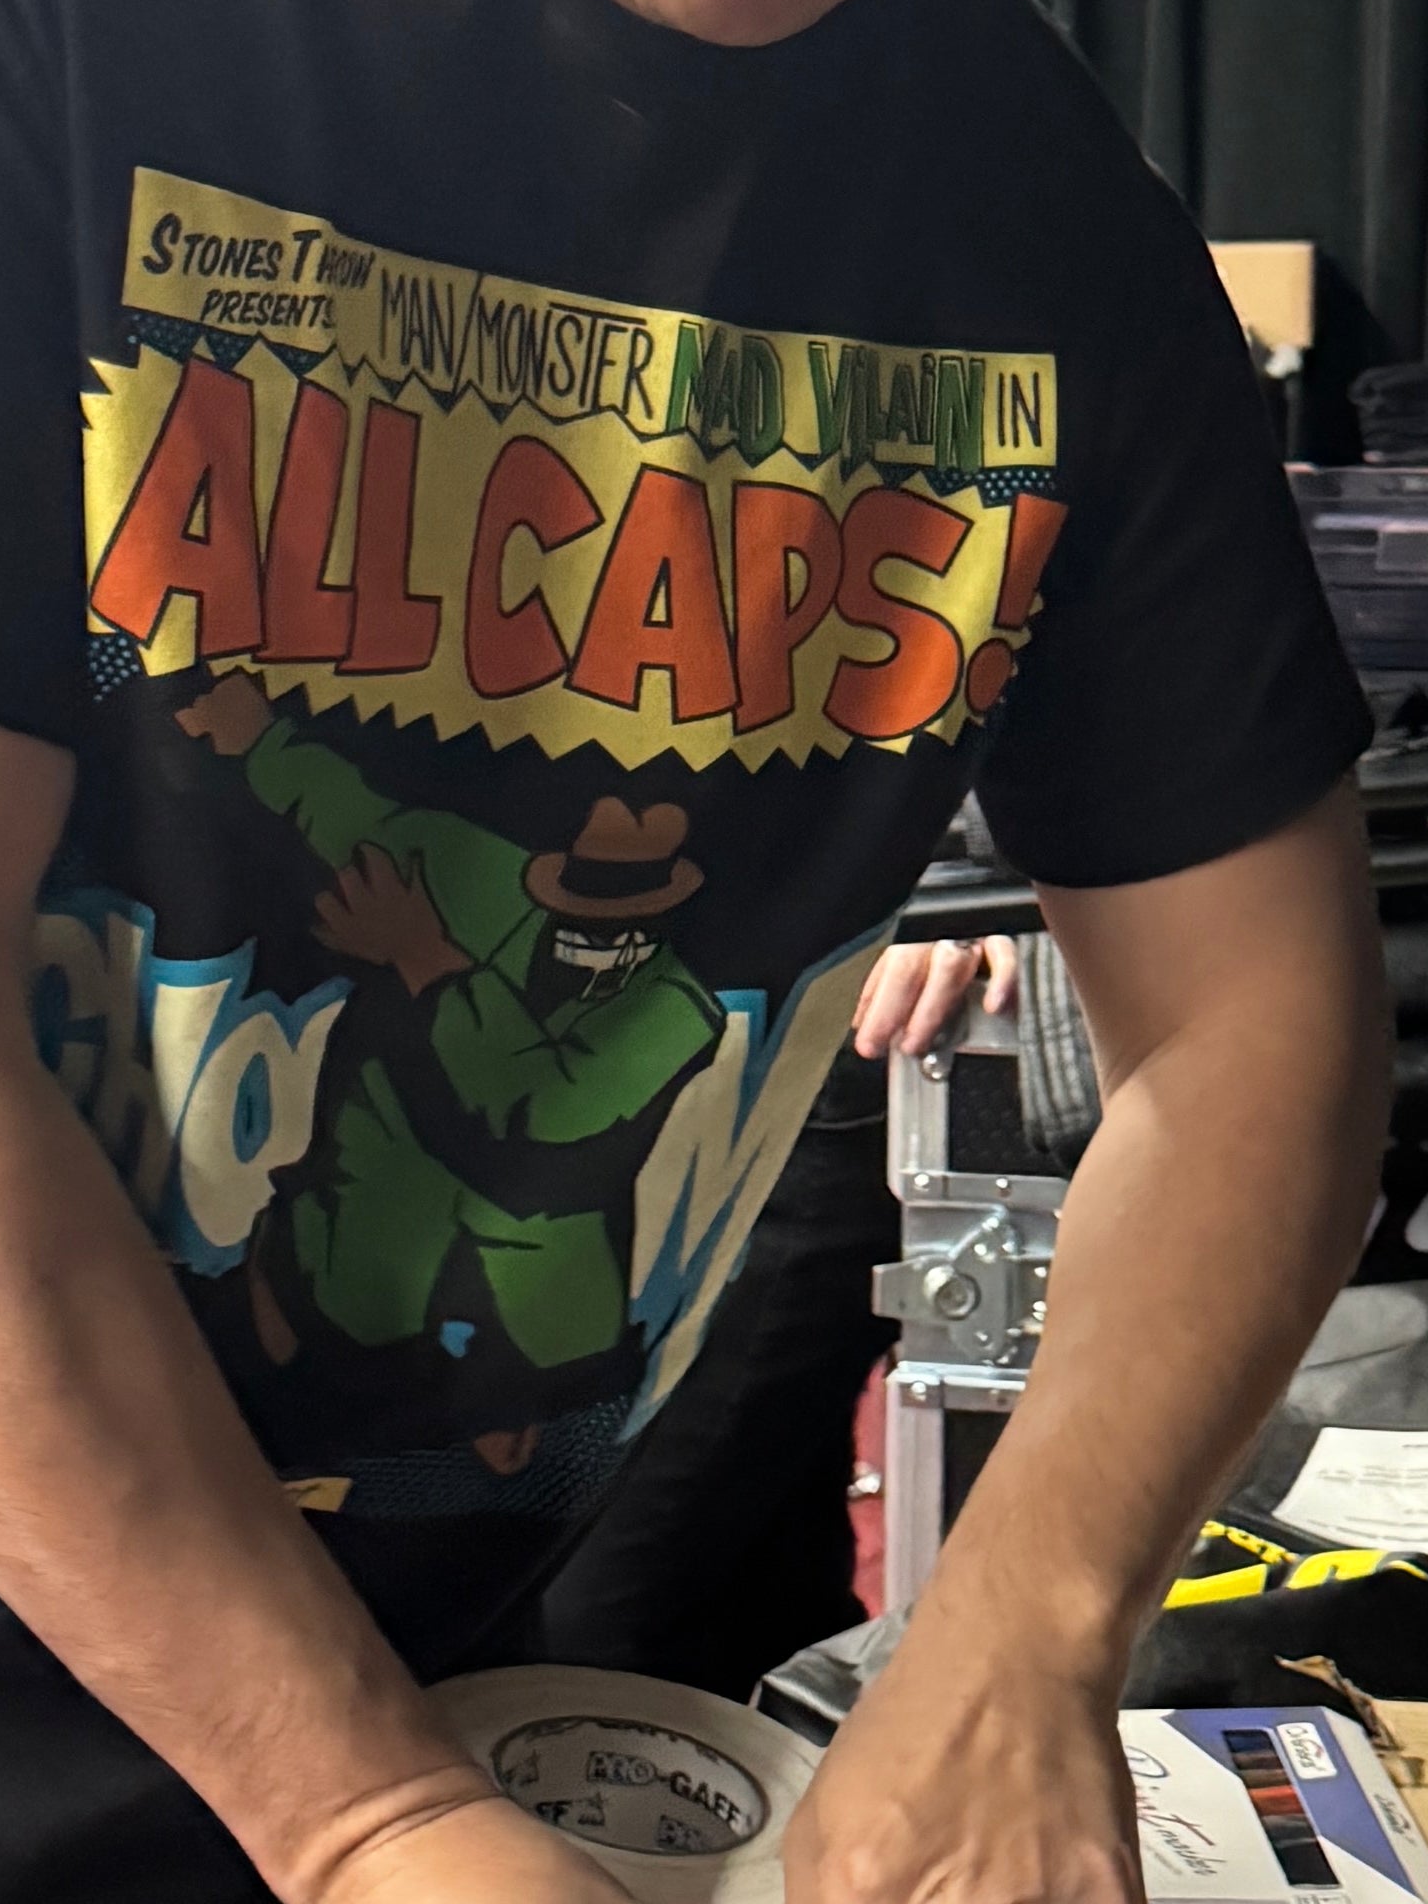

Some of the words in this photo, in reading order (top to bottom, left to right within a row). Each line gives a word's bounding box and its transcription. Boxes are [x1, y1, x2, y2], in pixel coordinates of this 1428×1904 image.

[141, 212, 284, 282] STONES
[996, 371, 1043, 450] IN
[88, 355, 443, 677] ALL
[465, 433, 1070, 741] CAPS!
